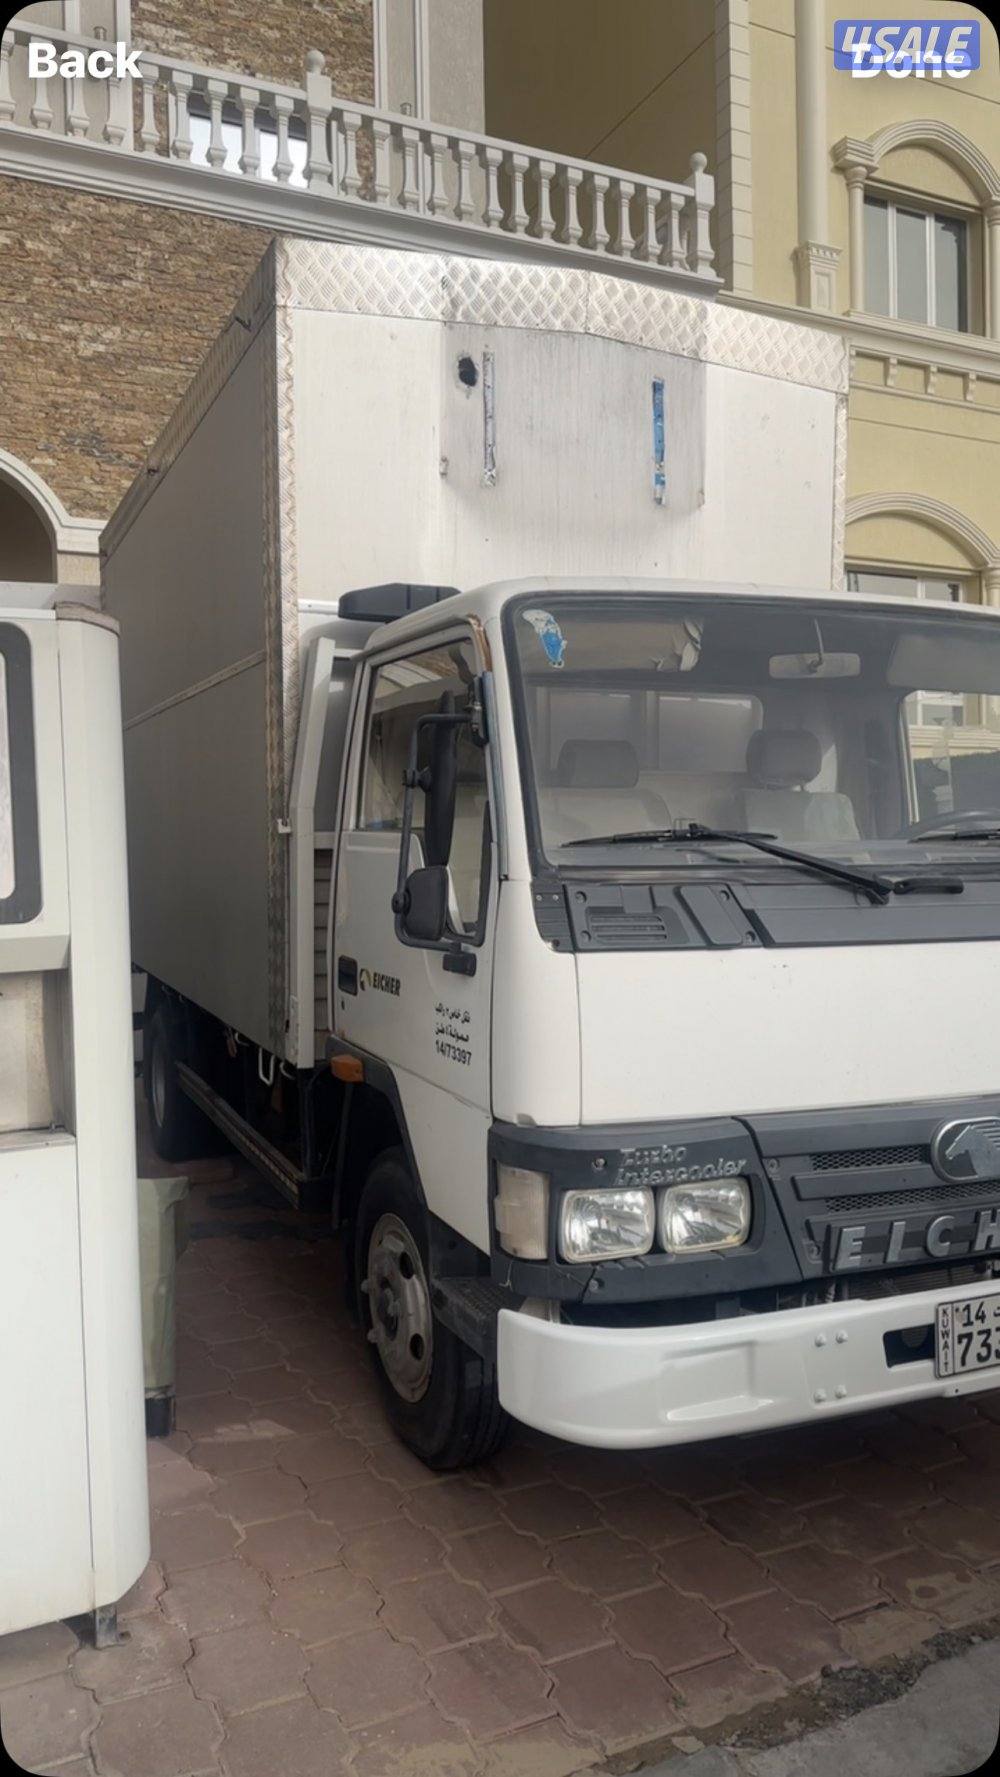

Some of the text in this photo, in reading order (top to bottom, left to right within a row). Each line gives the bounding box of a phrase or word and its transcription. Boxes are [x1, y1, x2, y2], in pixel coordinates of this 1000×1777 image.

[373, 971, 401, 997] EICHER
[435, 1039, 472, 1066] 14/73397
[620, 1144, 687, 1167] Turbo
[961, 1301, 987, 1327] 14
[941, 1307, 951, 1373] KUWAIT
